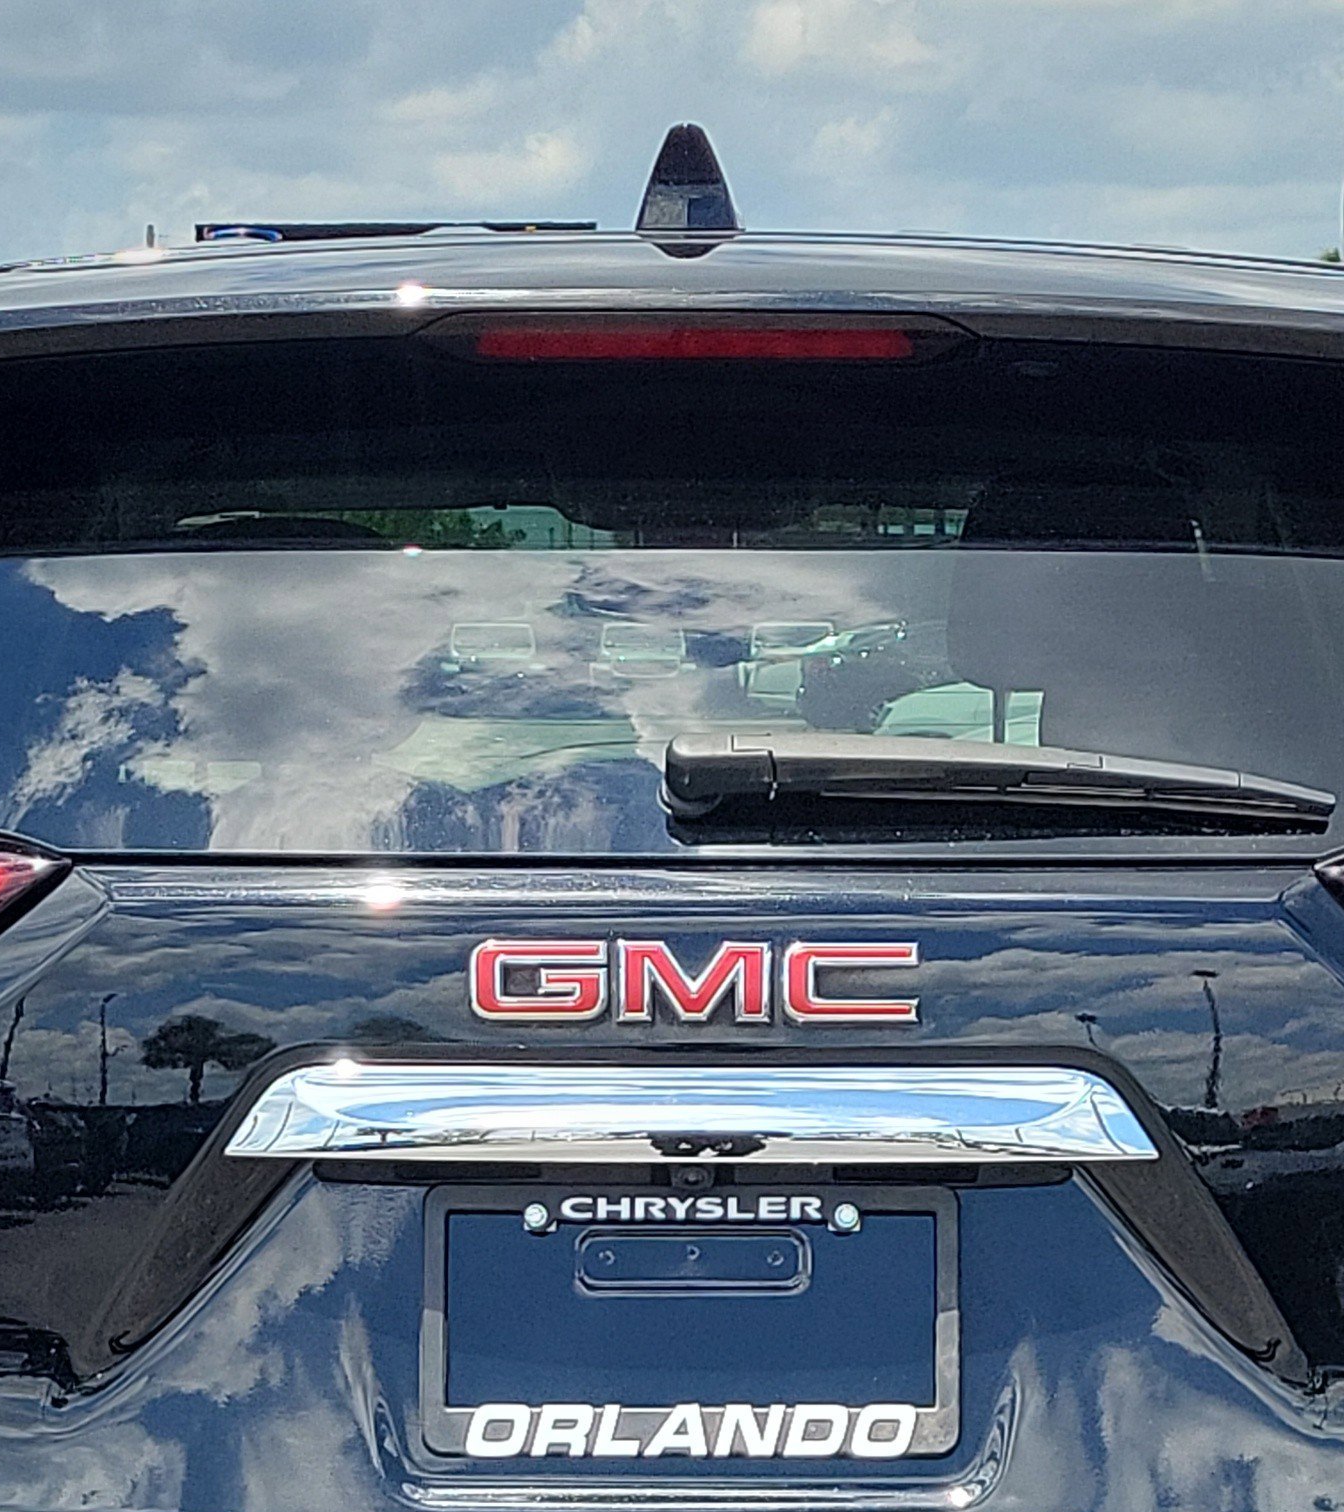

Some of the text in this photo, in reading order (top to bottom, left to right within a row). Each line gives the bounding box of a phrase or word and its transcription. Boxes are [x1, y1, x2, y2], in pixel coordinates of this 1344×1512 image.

[468, 938, 920, 1023] GMC
[559, 1196, 823, 1221] CHRYSLER
[463, 1402, 918, 1459] ORLANDO
